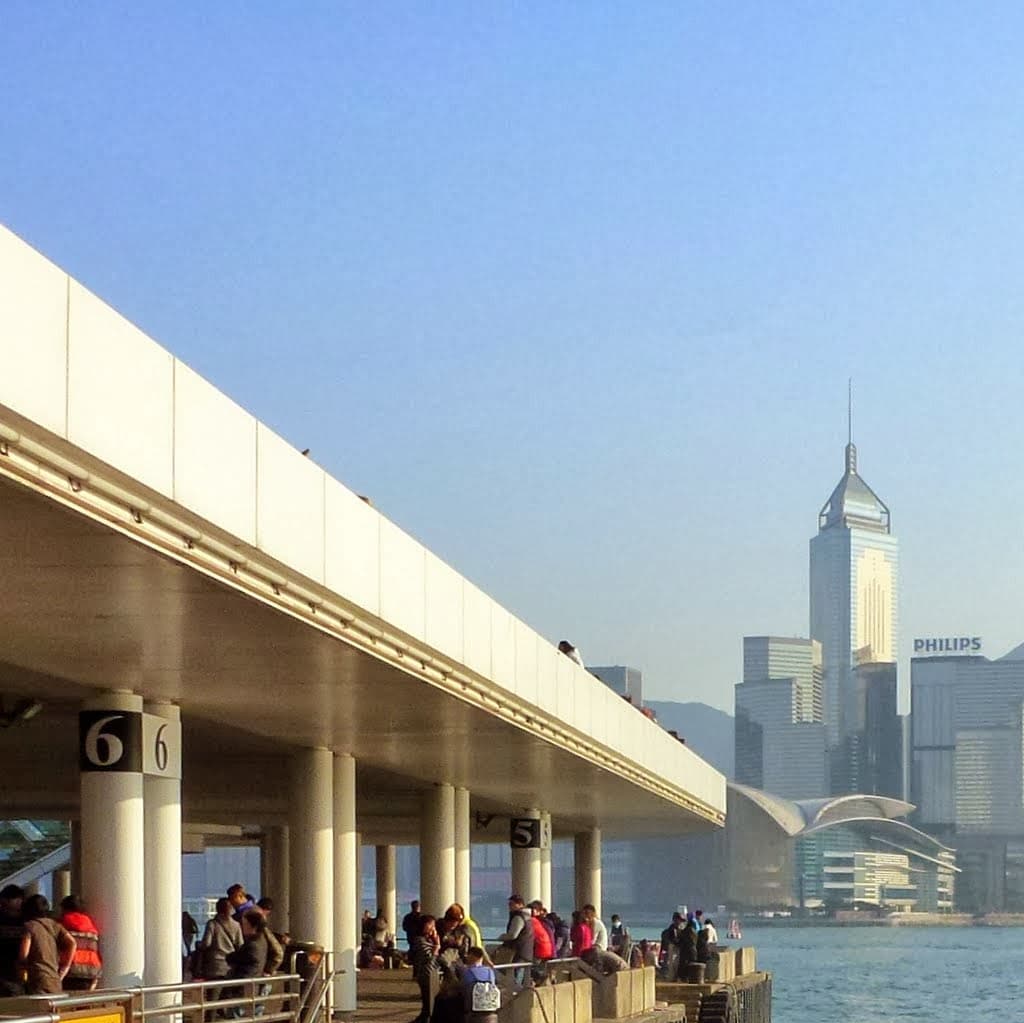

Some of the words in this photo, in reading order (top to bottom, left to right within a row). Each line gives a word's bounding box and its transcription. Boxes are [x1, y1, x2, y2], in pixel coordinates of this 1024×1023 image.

[914, 637, 982, 652] PHILIPS
[85, 715, 124, 766] 6
[155, 723, 168, 771] 6
[513, 821, 532, 846] 5
